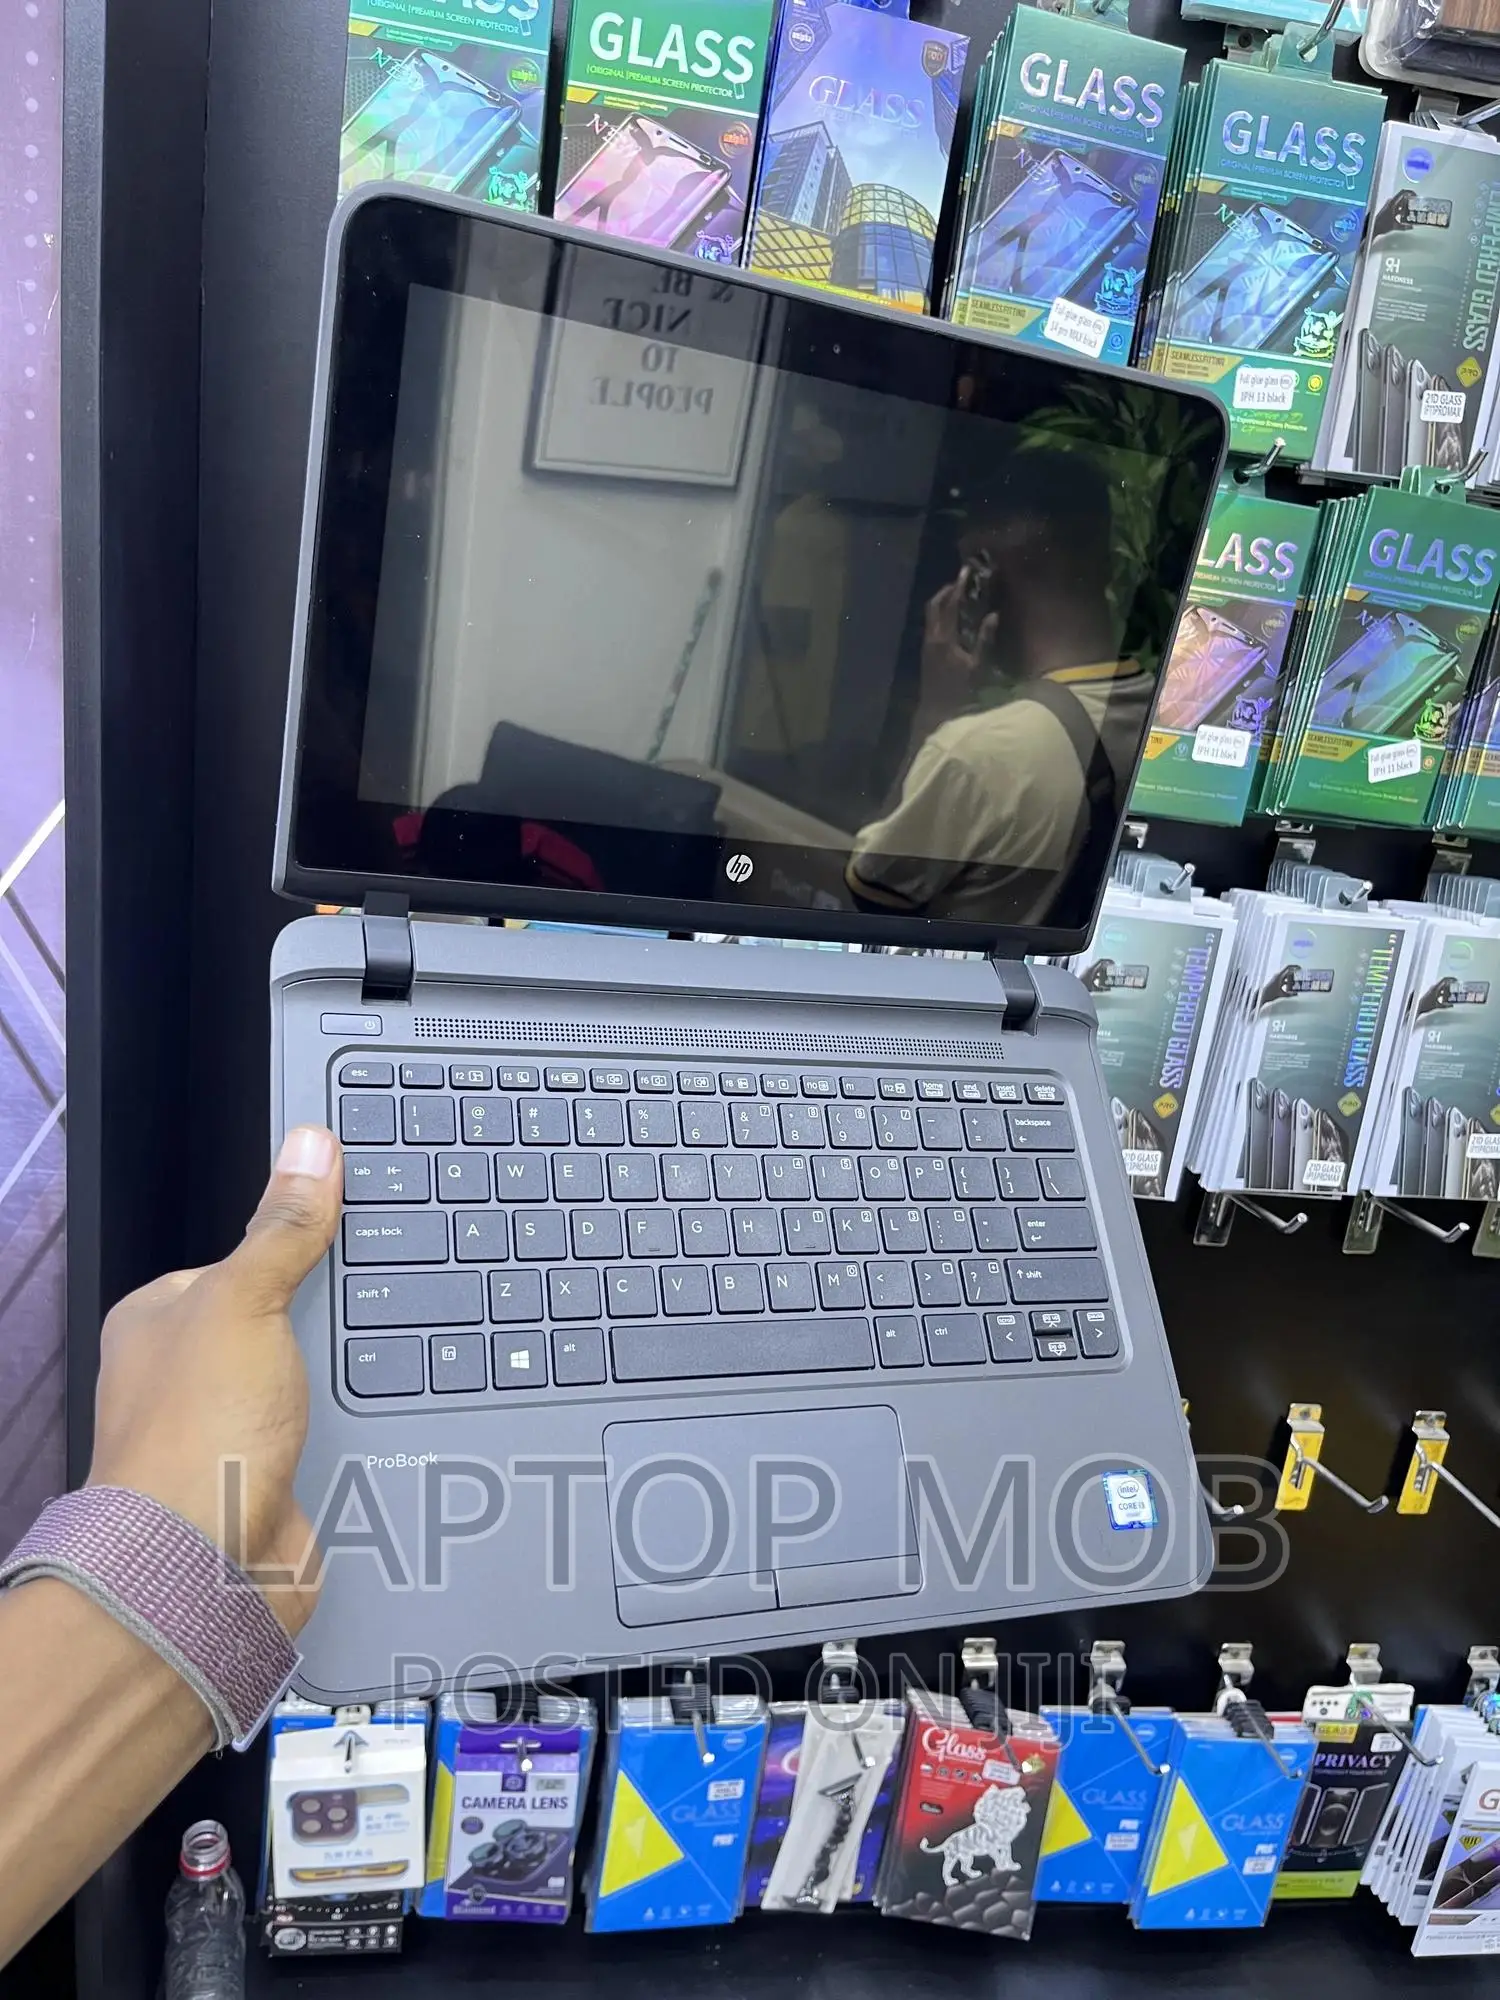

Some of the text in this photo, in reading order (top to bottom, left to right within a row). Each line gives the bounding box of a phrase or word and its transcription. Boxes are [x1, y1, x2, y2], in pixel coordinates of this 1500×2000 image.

[445, 12, 474, 25] SCREEN
[475, 18, 519, 34] PROTECTOR
[589, 12, 756, 83] GLASS
[662, 77, 690, 90] SCREEN
[691, 82, 733, 98] PROTECTOR
[1020, 53, 1165, 128] GLASS
[809, 75, 924, 128] GLASS
[1222, 110, 1366, 175] GLASS
[1462, 287, 1495, 352] GLASS
[1267, 392, 1286, 404] black
[1440, 393, 1462, 406] GLASS
[1369, 528, 1497, 586] GLASS
[1396, 760, 1414, 772] black
[727, 855, 753, 882] hp
[1159, 947, 1212, 1090] TEMPERED GLASS
[351, 1069, 369, 1077] esc
[455, 1072, 465, 1081] f2
[503, 1072, 513, 1081] f3
[550, 1073, 560, 1082] f4
[596, 1074, 605, 1083] f5
[640, 1077, 649, 1085] f6
[683, 1078, 691, 1086] f7
[766, 1080, 775, 1088] f9
[922, 1081, 944, 1090] home
[963, 1083, 977, 1091] end
[996, 1084, 1016, 1092] insert
[1034, 1085, 1056, 1093] delete
[1015, 1118, 1051, 1127] backspace
[413, 1125, 420, 1136] 1
[473, 1126, 482, 1137] 2
[531, 1126, 540, 1137] 3
[587, 1126, 596, 1137] 4
[640, 1128, 649, 1139] 5
[691, 1128, 700, 1139] 6
[741, 1129, 750, 1140] 7
[791, 1130, 800, 1140] 8
[838, 1131, 847, 1141] 9
[885, 1131, 894, 1143] 0
[354, 1166, 371, 1176] tab
[448, 1164, 462, 1179] Q
[507, 1165, 524, 1177] W
[564, 1165, 574, 1177] E
[618, 1166, 629, 1178] R
[671, 1165, 680, 1177] T
[723, 1166, 734, 1178] Y
[773, 1166, 783, 1178] U
[870, 1167, 881, 1179] O
[915, 1167, 924, 1179] P
[525, 1222, 536, 1236] S
[582, 1222, 594, 1235] D
[637, 1221, 647, 1234] F
[692, 1220, 703, 1234] G
[743, 1220, 754, 1233] H
[793, 1220, 801, 1232] J
[843, 1219, 853, 1232] K
[890, 1219, 899, 1231] L
[1027, 1220, 1046, 1228] enter
[355, 1226, 403, 1238] caps lock
[466, 1224, 480, 1237] A
[828, 1274, 840, 1287] M
[1026, 1270, 1042, 1279] shift
[617, 1280, 629, 1293] C
[671, 1278, 683, 1291] V
[725, 1277, 735, 1289] B
[777, 1275, 788, 1288] N
[356, 1288, 379, 1299] shift
[500, 1283, 512, 1297] Z
[559, 1281, 571, 1295] X
[885, 1329, 896, 1338] alt
[934, 1327, 948, 1336] ctrl
[563, 1342, 576, 1352] alt
[358, 1352, 376, 1362] ctrl
[444, 1348, 455, 1359] fn
[367, 1451, 438, 1469] ProBook
[1119, 1502, 1137, 1511] CORE
[922, 1726, 988, 1762] Glass
[1314, 1753, 1396, 1769] PRIVACY
[1082, 1787, 1148, 1805] GLASS
[461, 1796, 569, 1810] CAMERA LENS
[1221, 1812, 1286, 1832] GLASS
